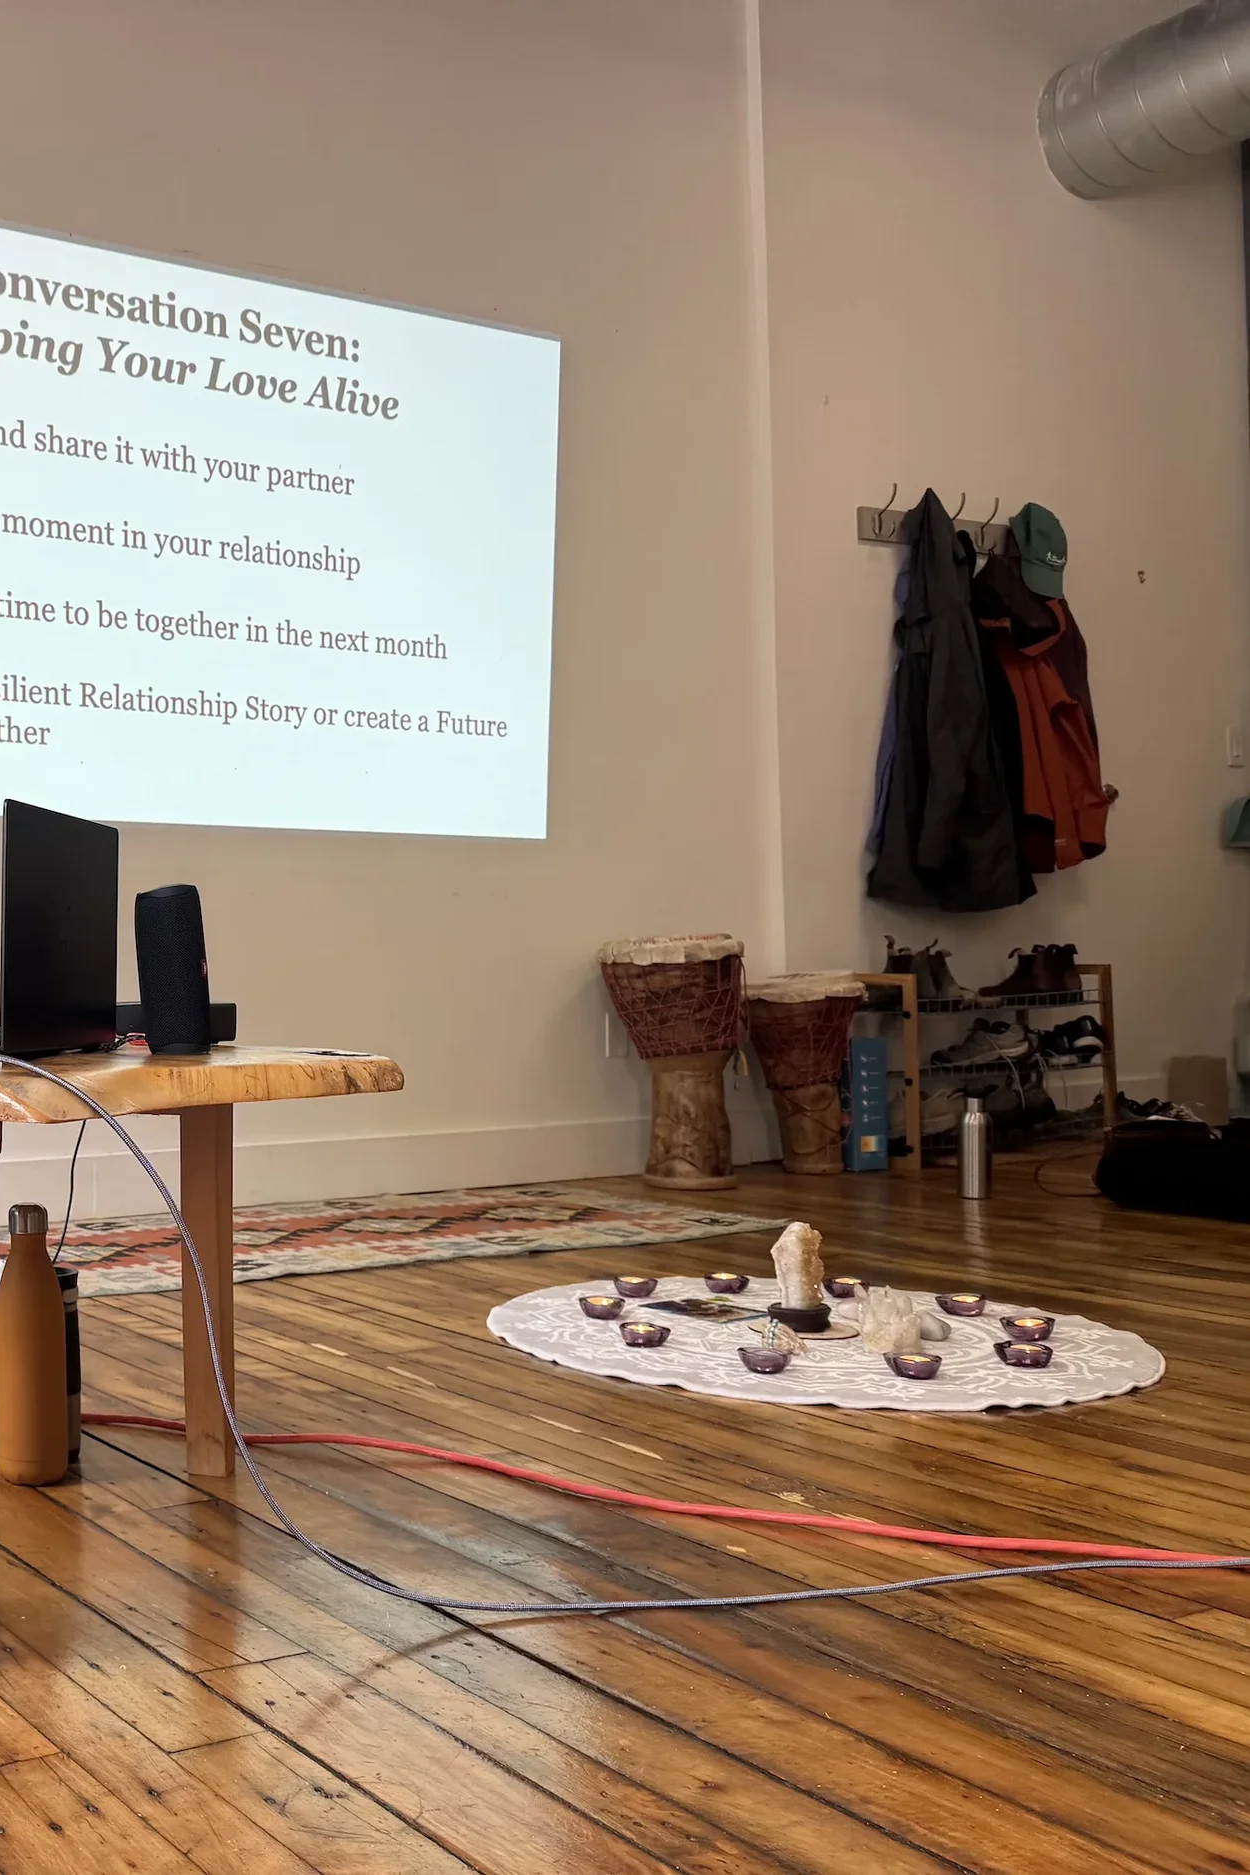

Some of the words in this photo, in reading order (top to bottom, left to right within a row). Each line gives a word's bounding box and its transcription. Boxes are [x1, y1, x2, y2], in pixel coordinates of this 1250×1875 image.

[239, 308, 360, 364] Seven:
[96, 335, 197, 387] Your
[203, 356, 298, 404] Love
[302, 375, 400, 421] Alive
[34, 423, 108, 463] share
[114, 435, 134, 465] it
[139, 442, 198, 474] with
[203, 457, 261, 491] your
[265, 466, 356, 496] partner
[1, 513, 115, 547] moment
[121, 520, 148, 551] in
[153, 532, 213, 559] your
[218, 534, 361, 582] relationship
[62, 600, 90, 626] to
[95, 599, 128, 630] be
[134, 608, 240, 642] together
[245, 615, 269, 644] in
[275, 618, 313, 648] the
[319, 630, 370, 653] next
[374, 633, 448, 660] month
[78, 681, 238, 726] Relationship
[245, 695, 308, 730] Story
[313, 707, 339, 726] or
[343, 708, 412, 731] create
[417, 714, 430, 733] a
[435, 710, 508, 738] Future
